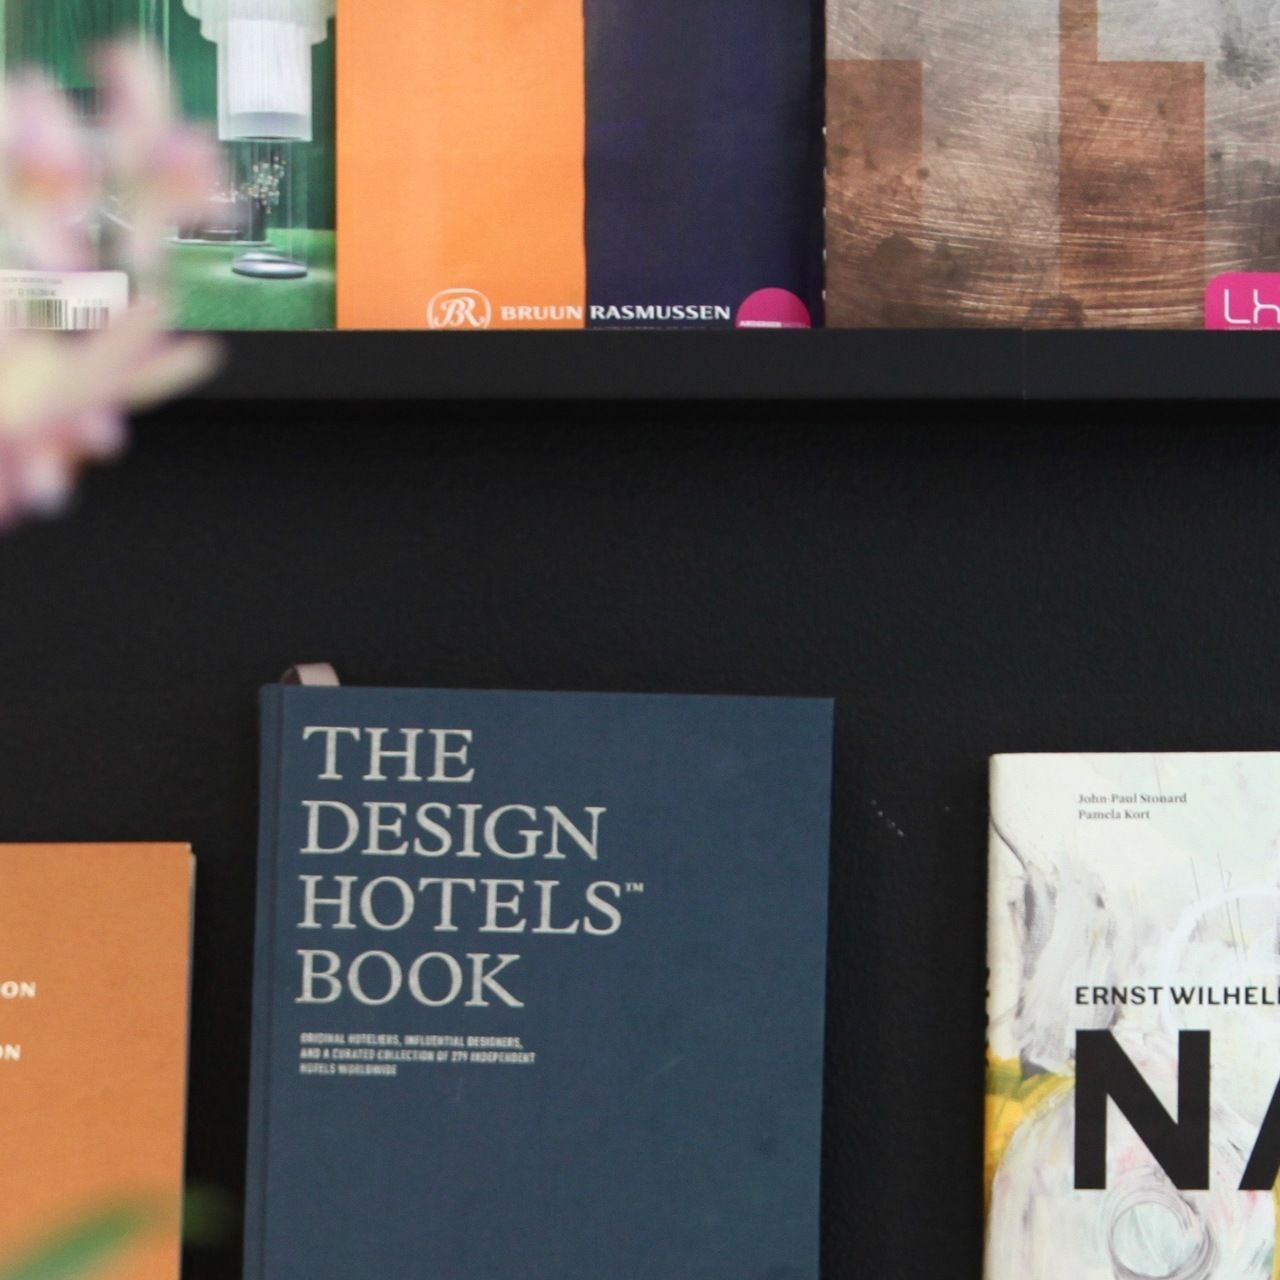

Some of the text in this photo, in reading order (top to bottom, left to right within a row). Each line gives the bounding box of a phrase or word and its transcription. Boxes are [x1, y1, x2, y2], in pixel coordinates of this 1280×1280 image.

[500, 304, 731, 321] BRUUN RASMUSSEN
[300, 725, 477, 783] THE
[1140, 792, 1188, 804] Stonard
[1078, 809, 1151, 820] Pamela Kort
[298, 799, 607, 861] DESIGN
[294, 949, 525, 1009] BOOK
[1075, 986, 1164, 1006] ERNST
[377, 1049, 434, 1062] COLLECTION
